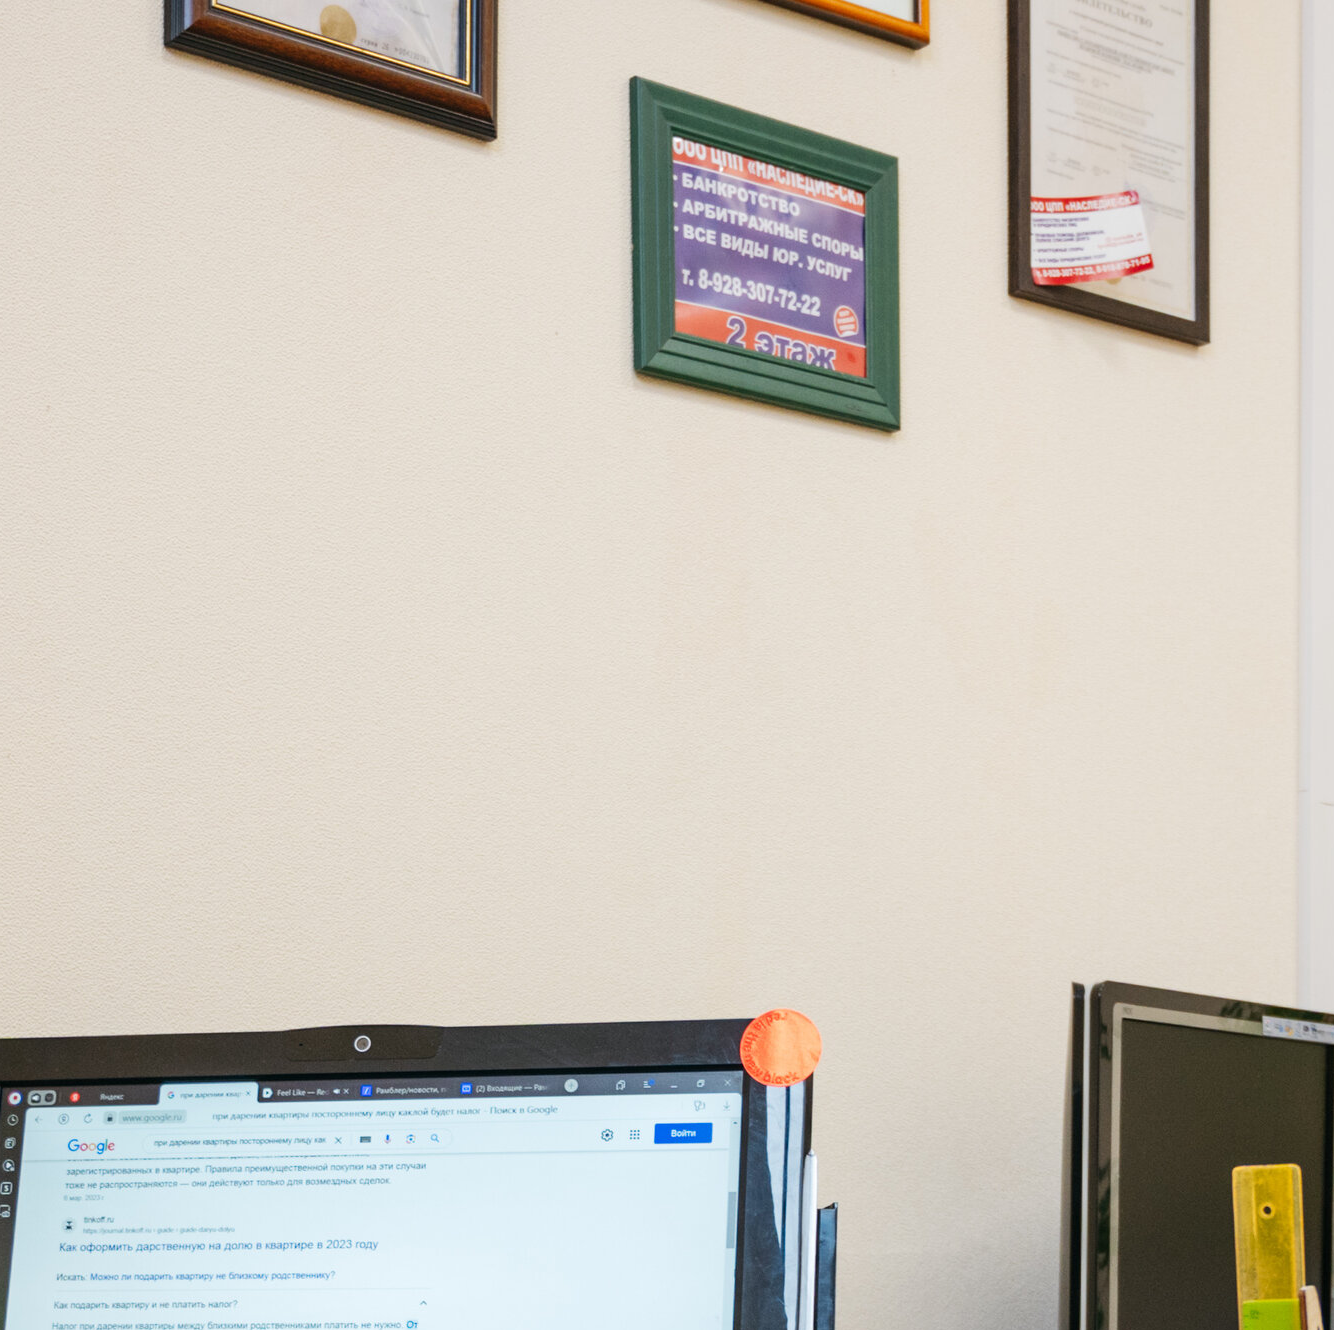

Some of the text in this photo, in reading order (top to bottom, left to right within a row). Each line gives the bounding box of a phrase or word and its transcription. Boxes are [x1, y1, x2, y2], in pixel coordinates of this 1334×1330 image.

[673, 137, 707, 160] ООО
[682, 172, 801, 217] БАНКРОТСТВО
[682, 199, 865, 262] АРБИТРАЖНЫЕ СПОРЫ
[683, 224, 853, 282] ВСЕ ВИДЫ ЮР. УСЛУГ
[698, 268, 821, 318] 8-928-307-72-22
[726, 315, 837, 371] 2 этаж
[763, 1070, 800, 1085] black
[277, 1088, 307, 1098] Feel Like
[475, 1083, 524, 1095] (2) Входящие
[99, 1093, 125, 1102] Яндекс
[122, 1113, 183, 1123] www.google.ru
[212, 1112, 227, 1122] при
[230, 1111, 267, 1121] дарении
[269, 1110, 309, 1120] квартиры
[311, 1109, 373, 1119] постороннему
[375, 1109, 396, 1118] лицу
[430, 1106, 454, 1117] будет
[456, 1107, 480, 1115] налог
[489, 1105, 517, 1115] Поиск
[526, 1104, 559, 1116] Google
[670, 1128, 697, 1139] Войти
[67, 1138, 115, 1155] Google
[66, 1166, 153, 1177] зарегистрированных
[205, 1164, 243, 1174] Правила
[245, 1163, 329, 1174] преимущественной
[331, 1164, 364, 1173] покупки
[396, 1162, 427, 1172] случаи
[59, 1239, 379, 1253] Как оформить дарственную на долю в квартире в 2023 году
[90, 1272, 120, 1281] Можно
[121, 1273, 132, 1281] ли
[134, 1273, 173, 1282] подарить
[175, 1272, 214, 1282] квартиру
[216, 1272, 227, 1280] не
[228, 1271, 269, 1281] близкому
[271, 1270, 336, 1282] родственнику?
[406, 1320, 419, 1330] От
